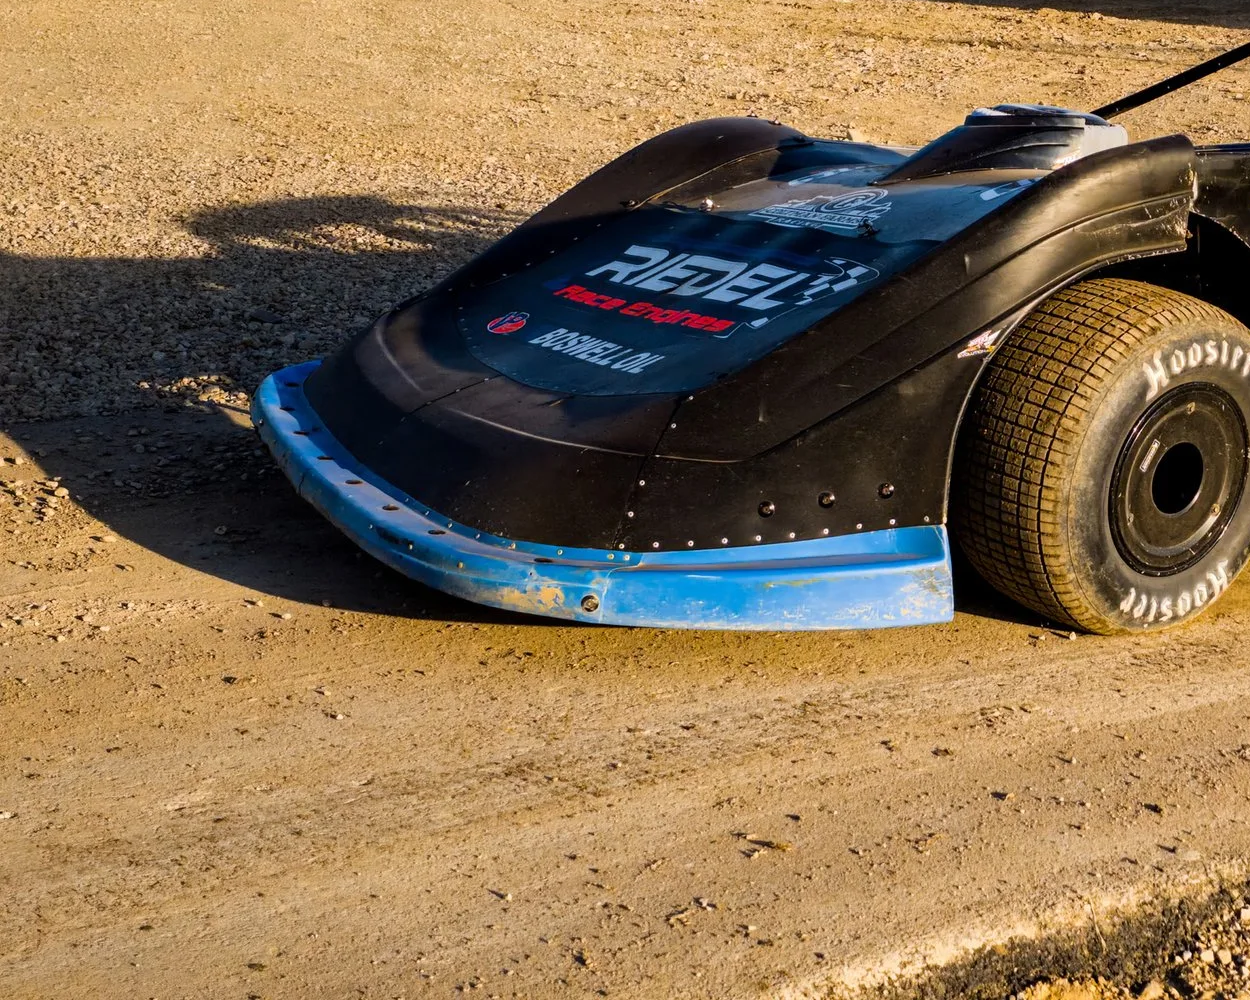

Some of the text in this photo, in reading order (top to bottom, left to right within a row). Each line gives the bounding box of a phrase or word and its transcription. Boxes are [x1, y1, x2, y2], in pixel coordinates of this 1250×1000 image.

[585, 244, 811, 311] RIEDEL
[553, 284, 736, 332] Race Engines
[528, 327, 666, 374] BOSWELL OIL
